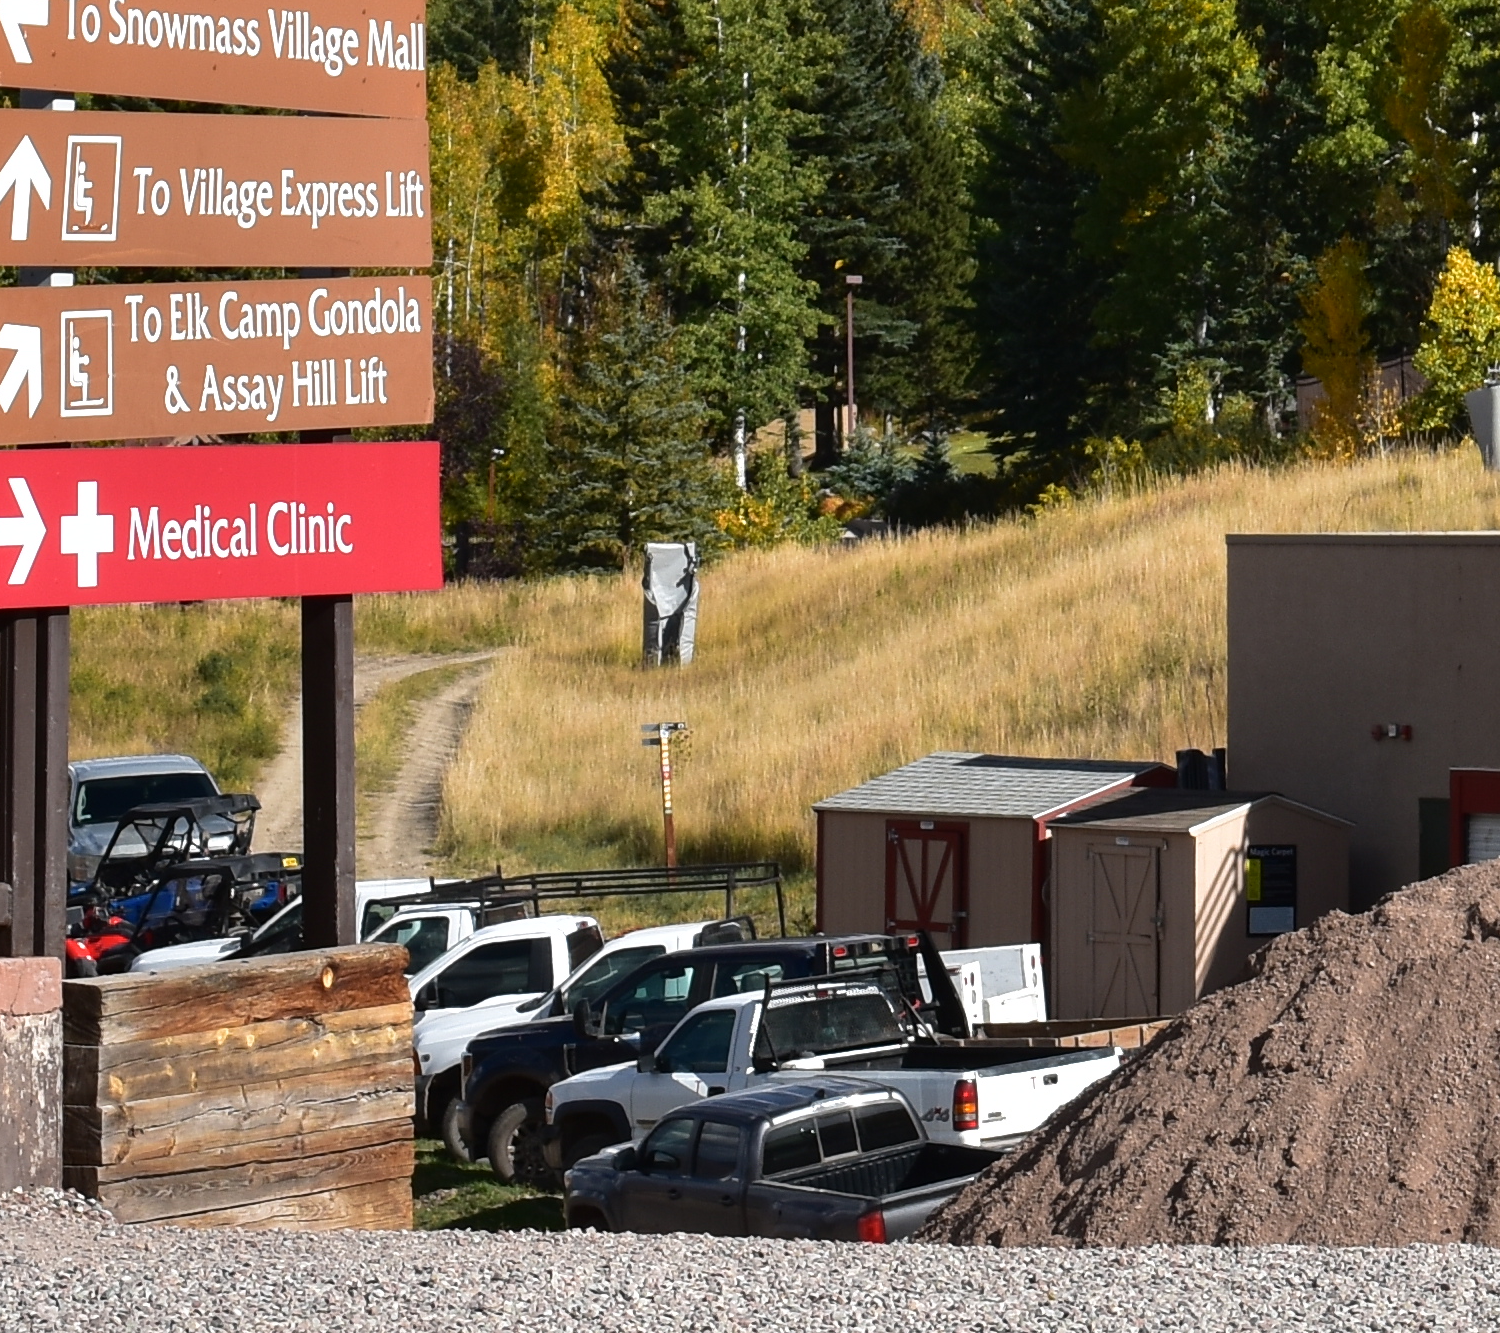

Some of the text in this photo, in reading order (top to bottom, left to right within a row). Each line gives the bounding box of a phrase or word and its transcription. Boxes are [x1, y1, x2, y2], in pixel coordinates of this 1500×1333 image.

[267, 8, 359, 77] Village
[366, 18, 425, 71] Mall
[133, 167, 425, 230] To Village Express Lift
[124, 286, 422, 349] To Elk Camp Gondola
[164, 356, 388, 422] & Assay Hill Lift
[127, 501, 353, 561] Medical Clinic
[1249, 847, 1294, 857] Magic Carpet
